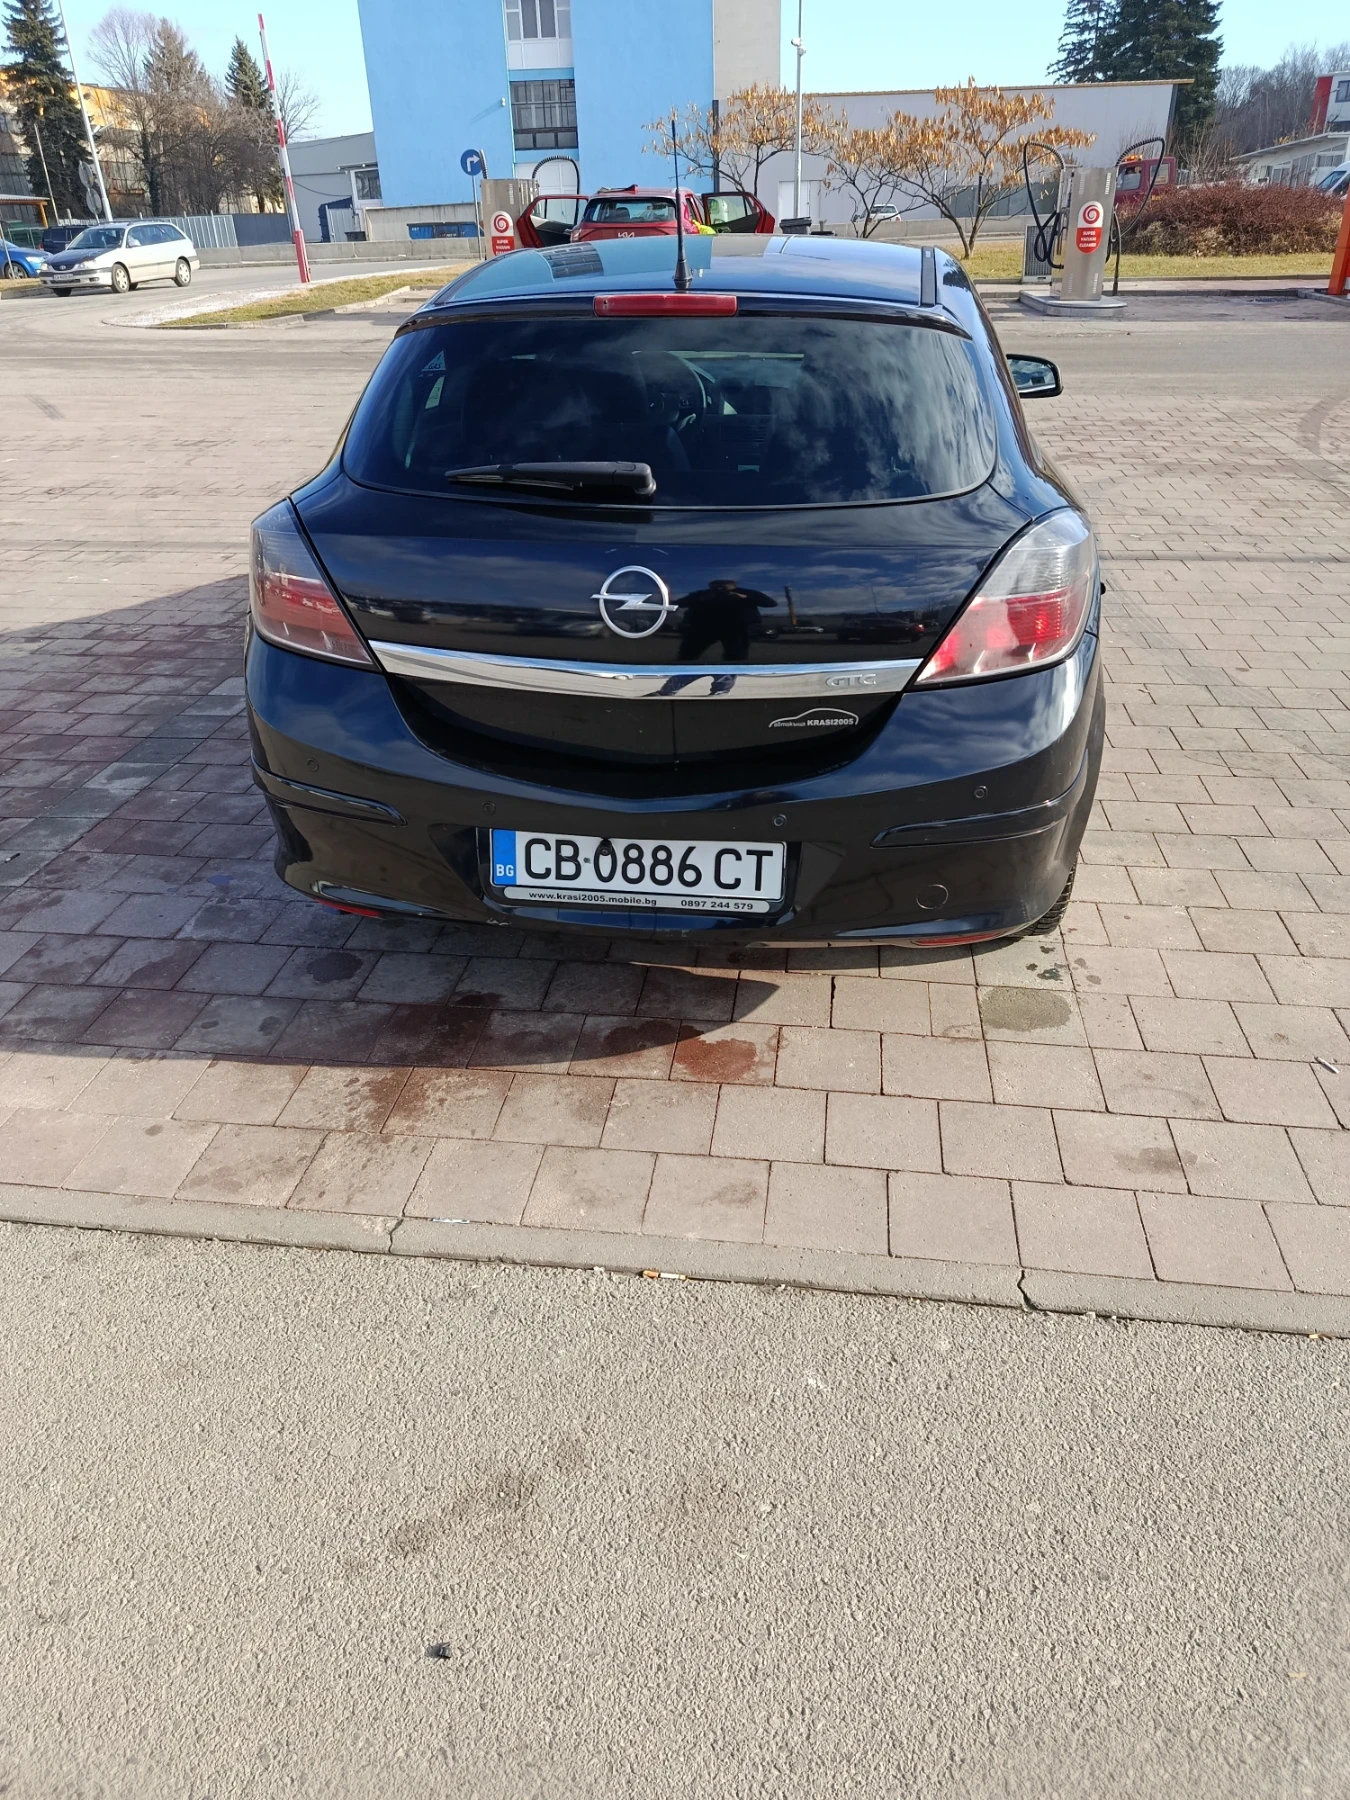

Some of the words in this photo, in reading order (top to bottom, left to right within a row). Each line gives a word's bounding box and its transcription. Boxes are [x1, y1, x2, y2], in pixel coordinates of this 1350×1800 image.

[825, 673, 877, 687] GTC
[806, 718, 854, 727] KRASI2005
[496, 863, 515, 877] BG
[524, 838, 582, 881] CB
[593, 839, 703, 888] 0886
[713, 848, 774, 892] CT
[528, 891, 658, 906] www.krasi2005.mobile.bg
[680, 899, 707, 908] 0897
[710, 901, 730, 909] 244
[733, 902, 754, 910] 579
